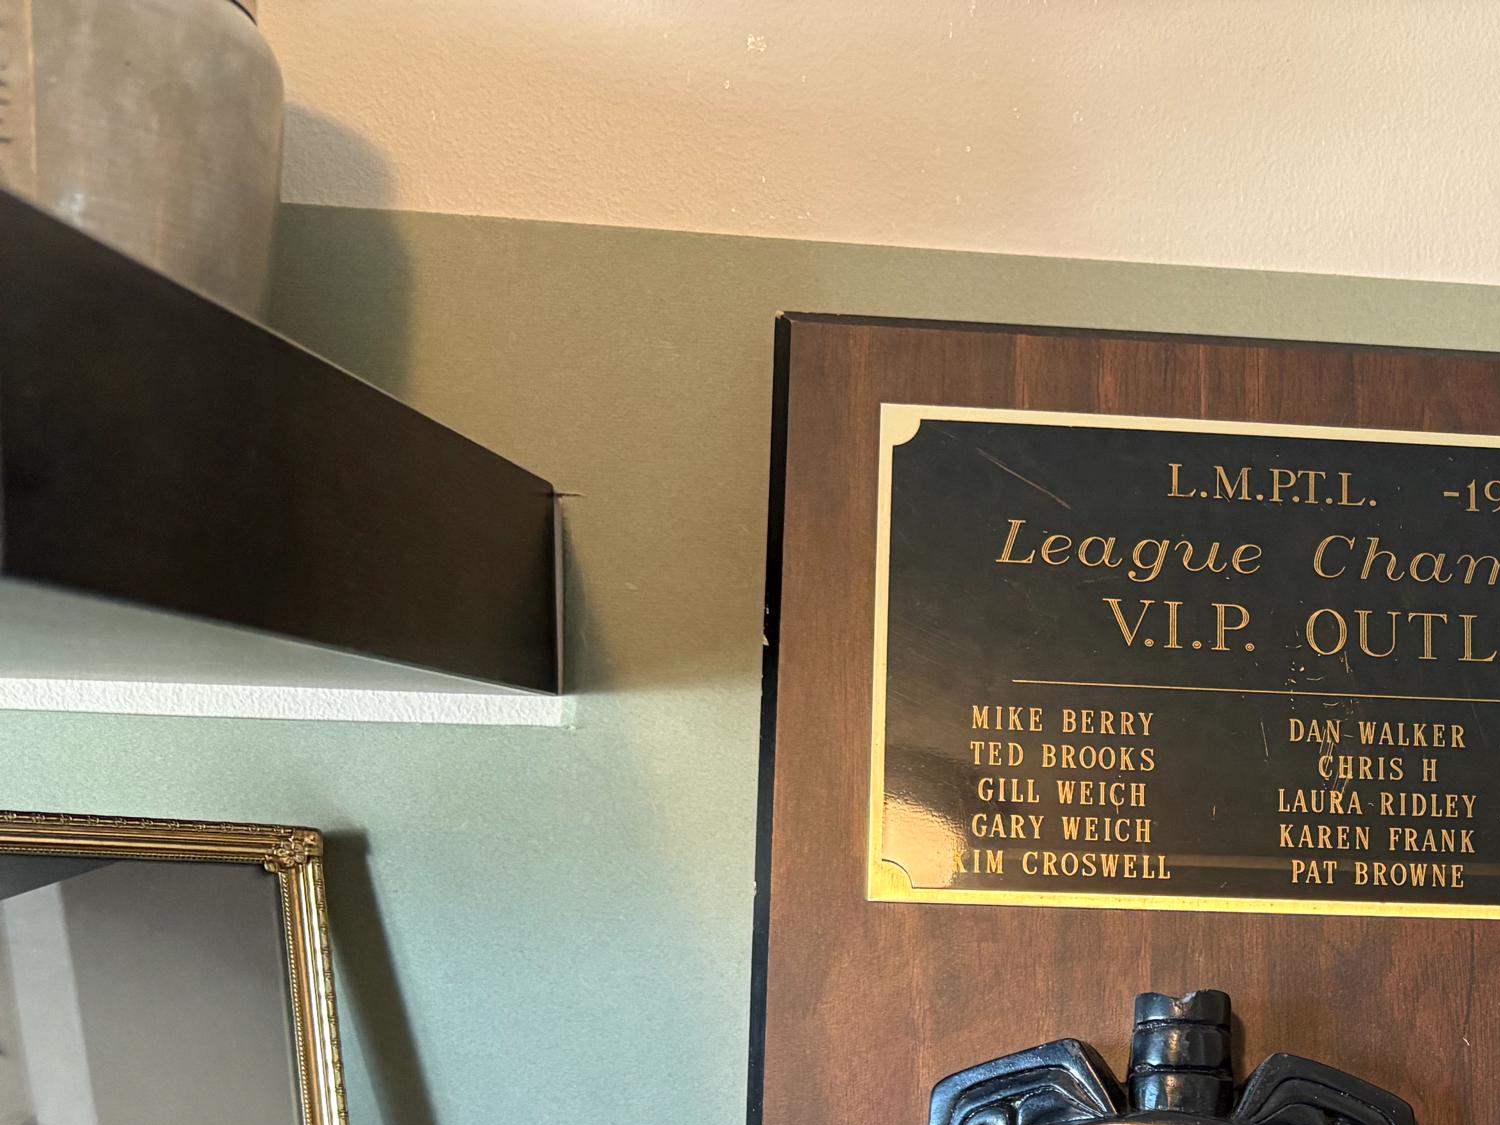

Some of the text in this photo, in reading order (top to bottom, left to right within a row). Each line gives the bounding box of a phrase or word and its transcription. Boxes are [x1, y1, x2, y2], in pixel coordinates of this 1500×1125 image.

[1167, 462, 1377, 507] L.M.P.T.L.
[995, 518, 1264, 583] League
[1102, 597, 1256, 652] V.I.P.
[971, 705, 1154, 736] MIKE BERRY
[1289, 718, 1466, 748] DAN WALKER
[970, 741, 1155, 772] TED BROOKS
[1319, 756, 1437, 782] CHRIS H
[977, 778, 1146, 807] GILL WEICH
[1278, 788, 1477, 818] LAURA RIDLEY
[971, 813, 1152, 843] GARY WEICH
[1279, 824, 1476, 853] KAREN FRANK
[952, 849, 1172, 879] KIM CROSWELL
[1292, 860, 1464, 888] PAT BROWNE
